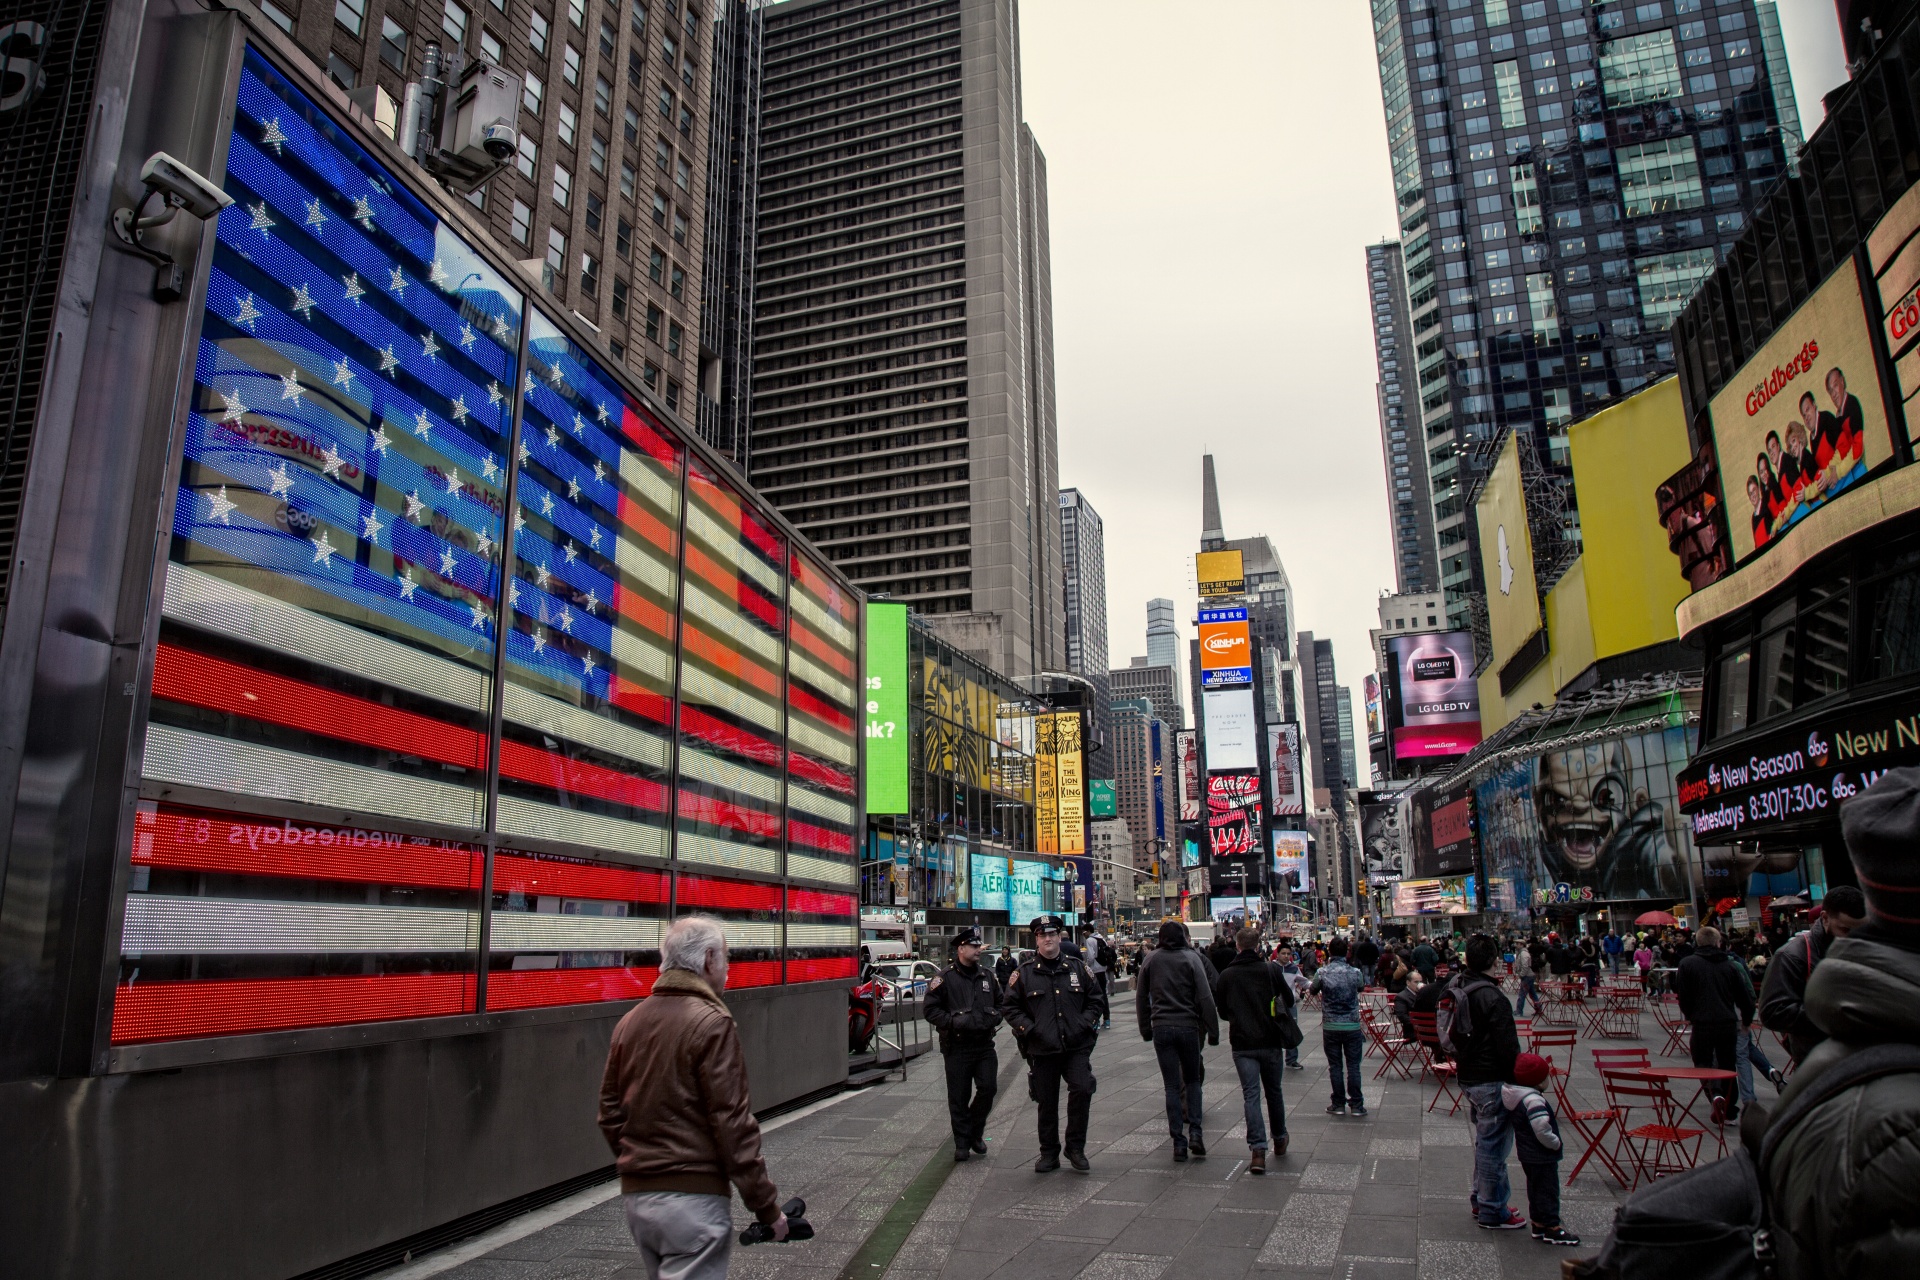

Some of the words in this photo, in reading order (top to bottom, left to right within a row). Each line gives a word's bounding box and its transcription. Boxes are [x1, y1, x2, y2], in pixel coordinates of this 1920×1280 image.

[1746, 338, 1819, 416] Goldbergs
[1210, 638, 1245, 647] XINHUA
[1212, 670, 1242, 678] XINHUA
[1419, 705, 1430, 713] LG
[1432, 703, 1457, 712] OLED
[1458, 702, 1470, 710] TV
[1835, 730, 1889, 760] New
[1895, 713, 1920, 748] N
[1808, 741, 1828, 757] abc
[1709, 771, 1721, 785] abc
[1722, 765, 1748, 789] New
[1750, 751, 1804, 781] Season
[1061, 776, 1078, 786] LION
[1061, 787, 1081, 798] KING
[1832, 782, 1856, 799] abc
[1693, 802, 1745, 834] Wednesdays
[981, 872, 1041, 895] AÉROOSTALE
